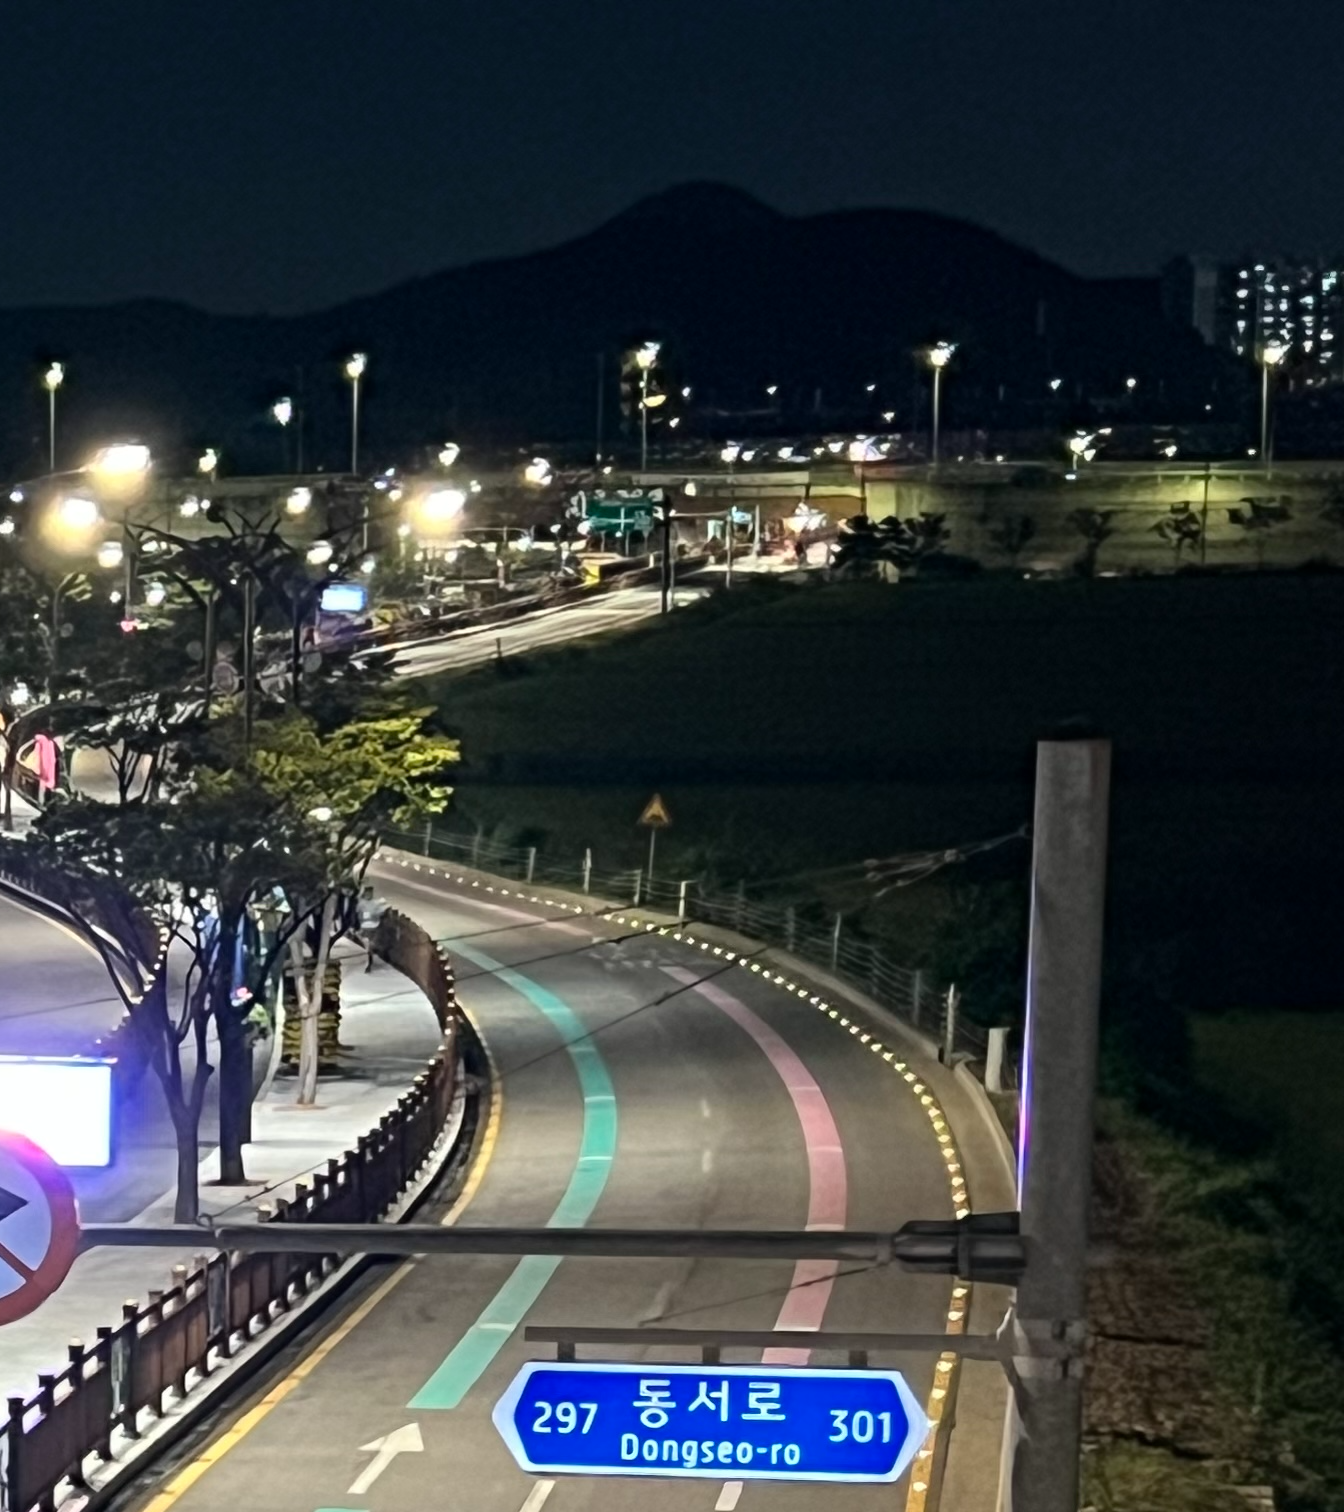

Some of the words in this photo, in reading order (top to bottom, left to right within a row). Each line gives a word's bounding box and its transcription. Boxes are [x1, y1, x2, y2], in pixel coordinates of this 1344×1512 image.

[531, 1401, 599, 1434] 297
[632, 1378, 787, 1429] 동서로
[828, 1409, 892, 1443] 301
[620, 1432, 802, 1469] Dongseo-ro
